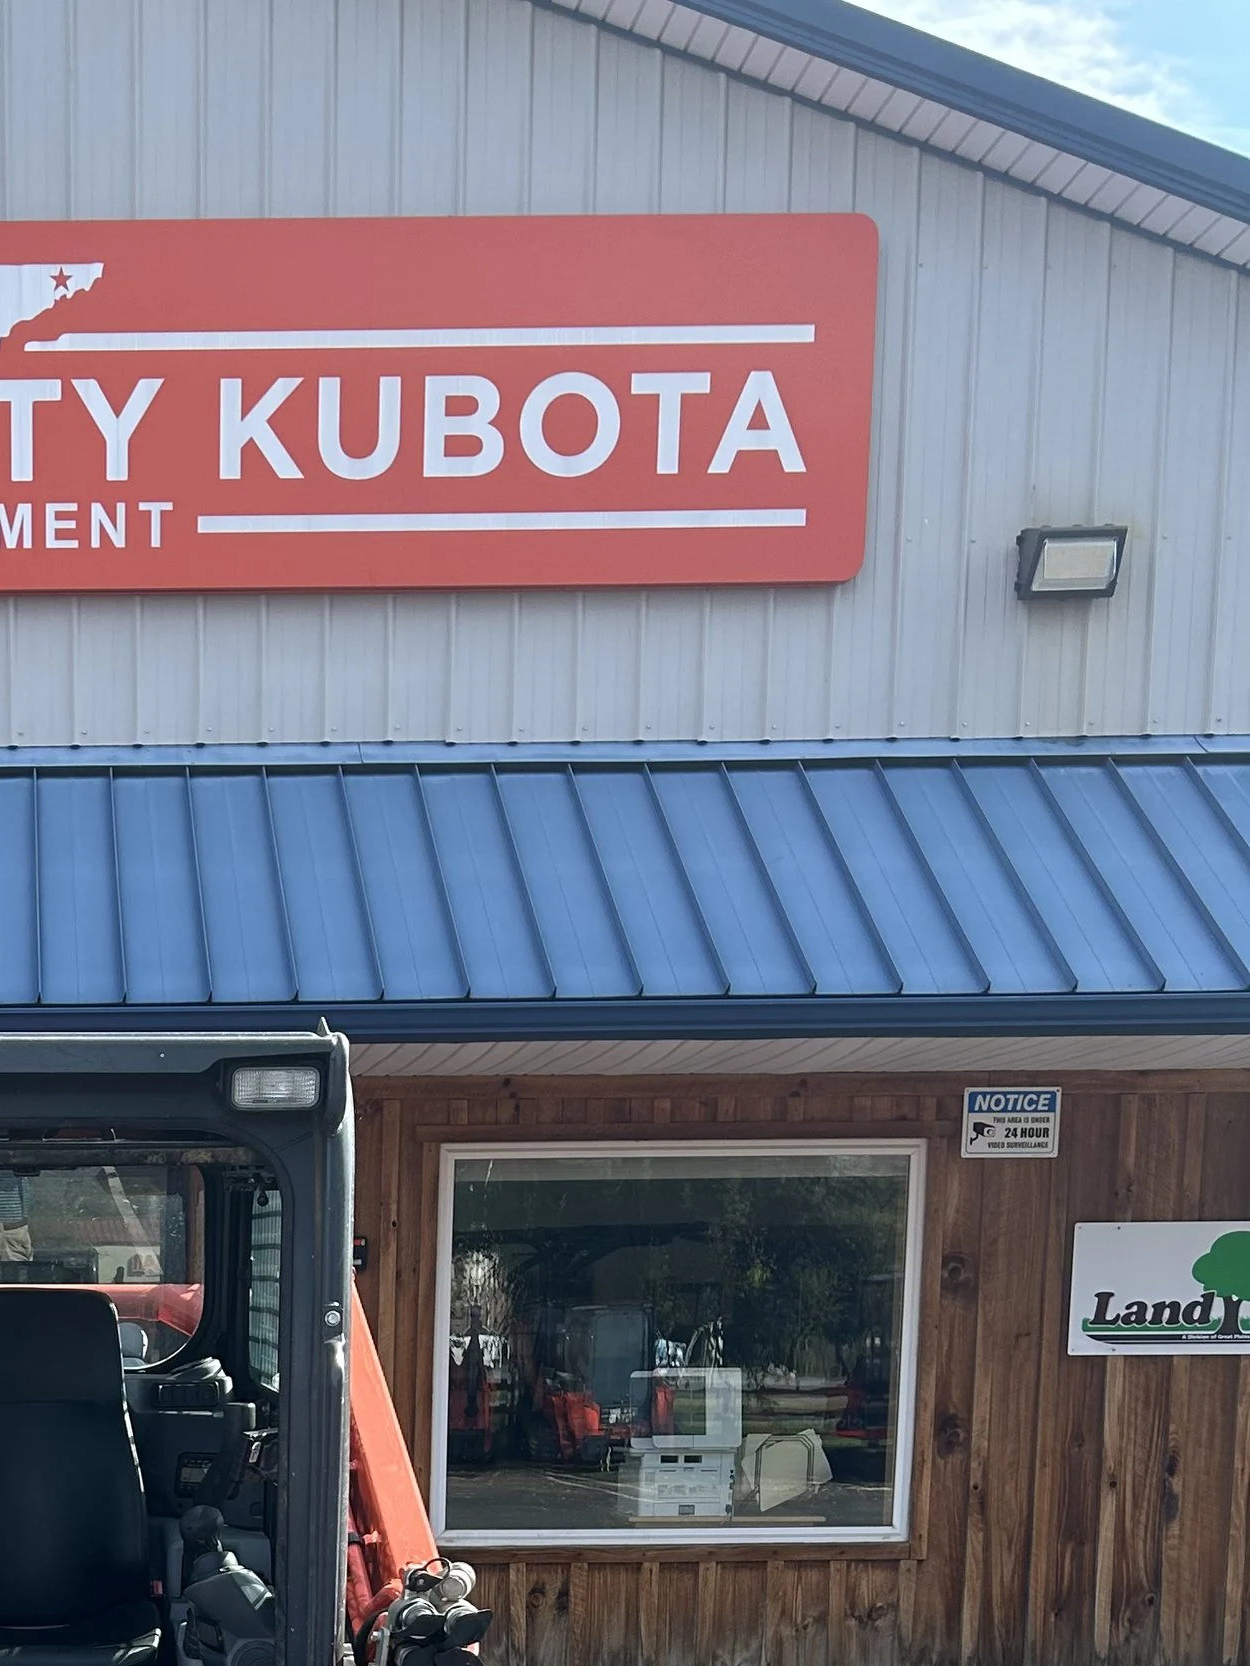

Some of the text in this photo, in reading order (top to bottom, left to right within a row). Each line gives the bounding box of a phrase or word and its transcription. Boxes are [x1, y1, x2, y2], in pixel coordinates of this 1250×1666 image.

[219, 370, 807, 480] KUBOTA
[974, 1094, 1051, 1111] NOTICE
[1004, 1127, 1050, 1138] 24 HOUR
[987, 1141, 1049, 1149] VIDEO SURVEILLANCE
[1088, 1291, 1216, 1326] Land
